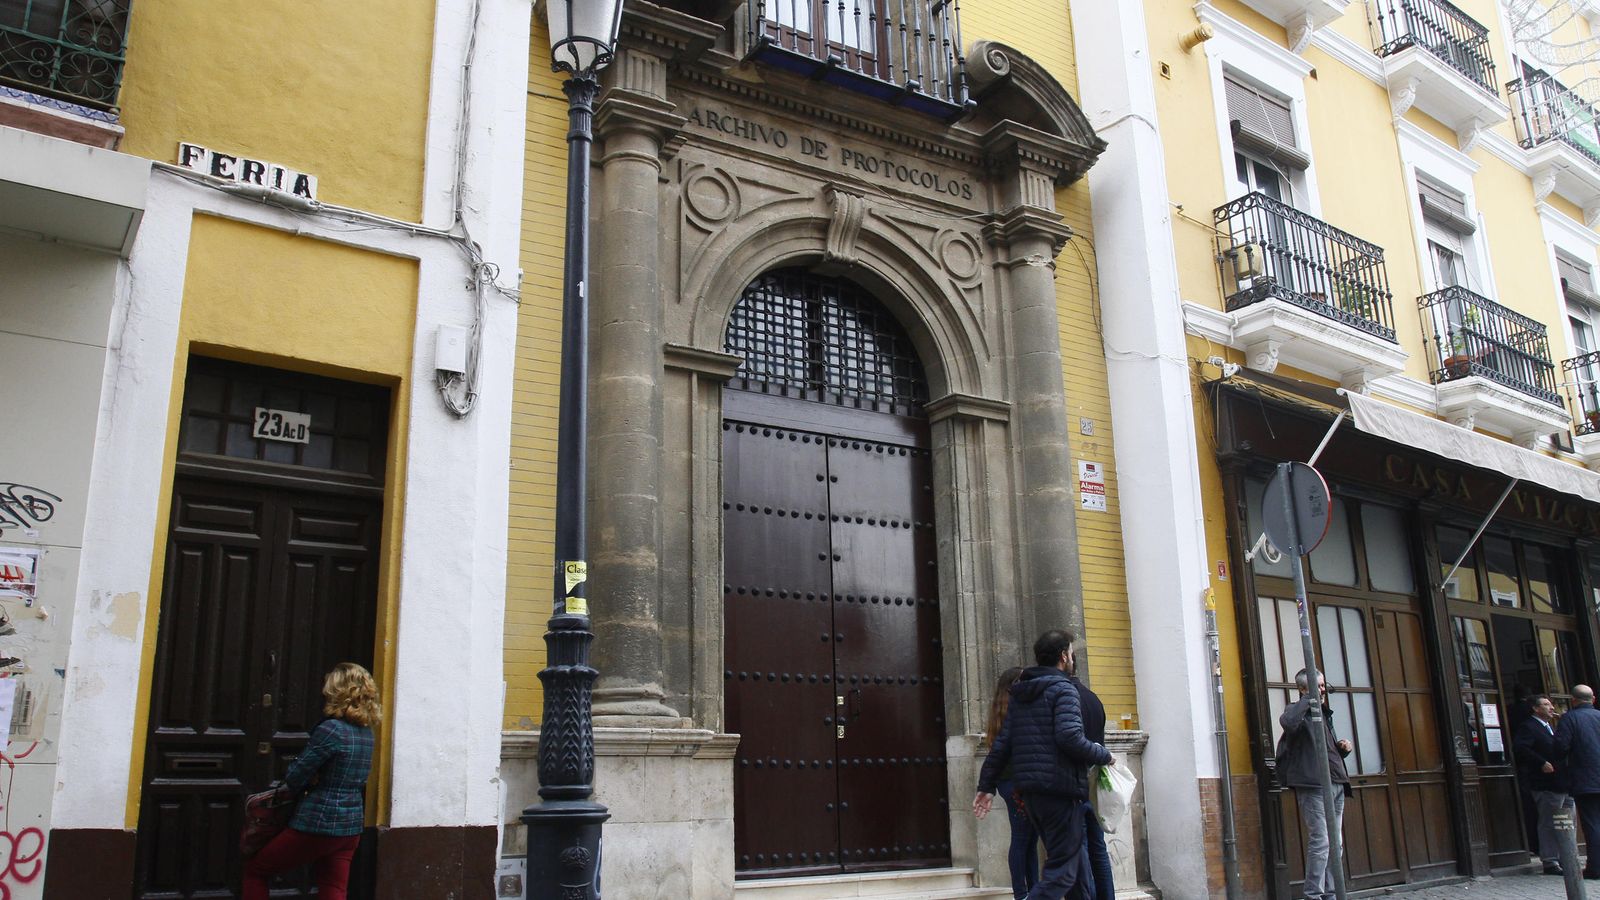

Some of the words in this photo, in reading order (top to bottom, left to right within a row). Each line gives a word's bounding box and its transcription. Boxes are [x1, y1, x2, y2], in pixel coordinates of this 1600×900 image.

[182, 145, 313, 198] FERIA
[688, 106, 788, 148] ARCHIVO
[801, 136, 828, 160] DE
[841, 147, 973, 200] PROTOCOLOS
[1081, 482, 1104, 491] Alarma
[1386, 454, 1471, 498] CASA
